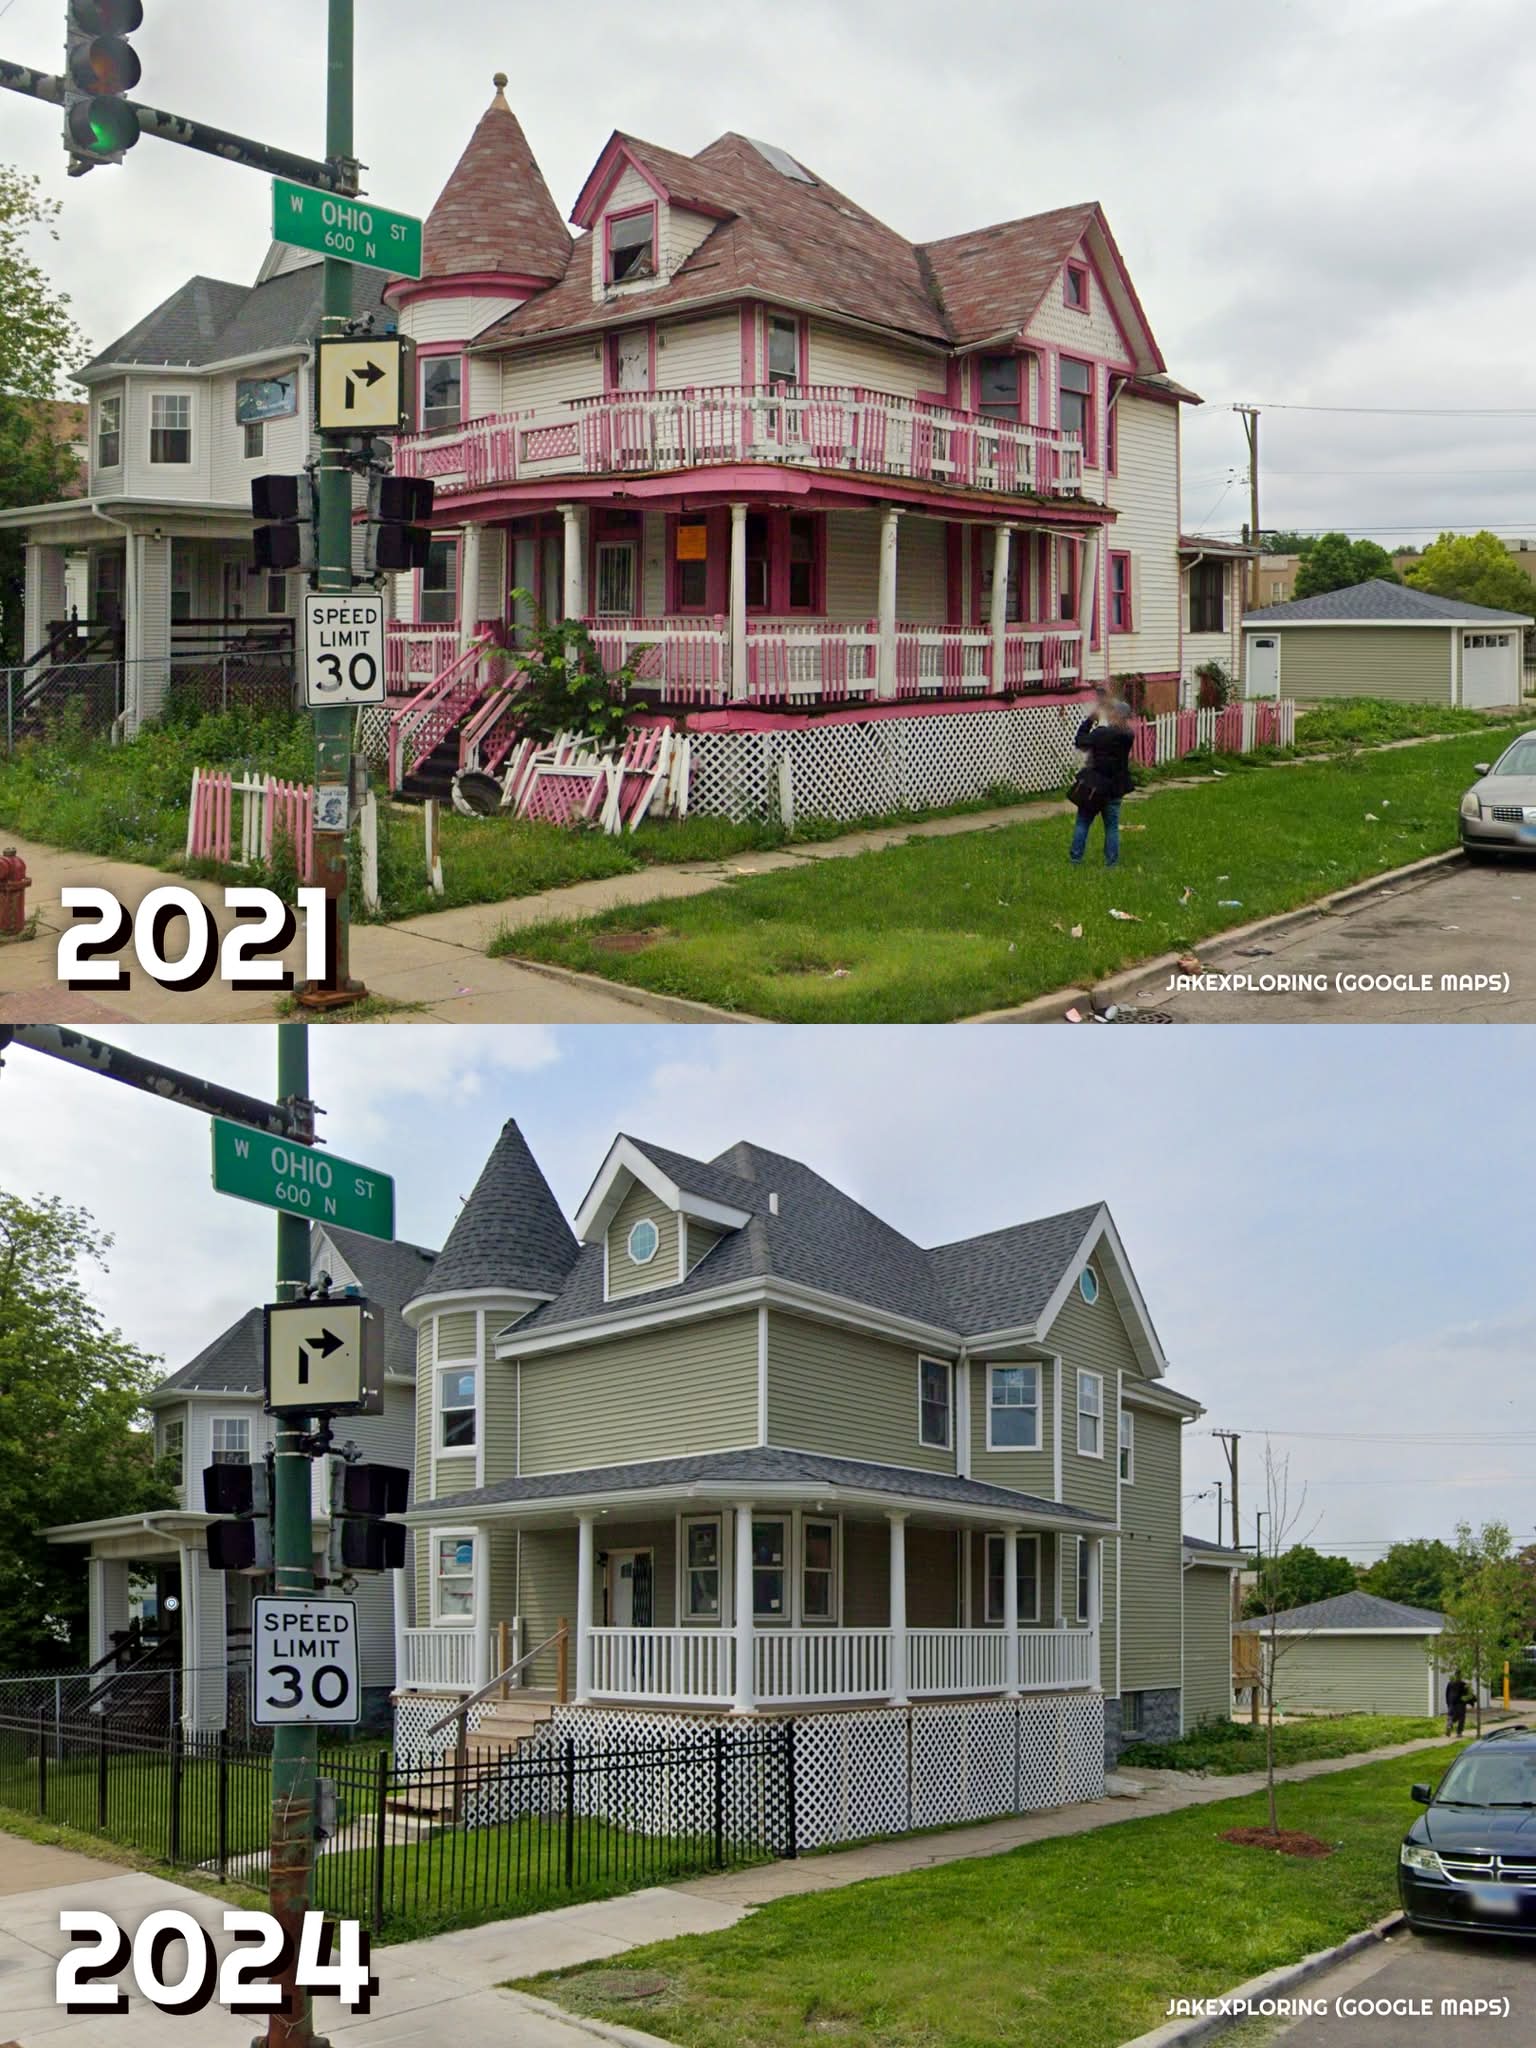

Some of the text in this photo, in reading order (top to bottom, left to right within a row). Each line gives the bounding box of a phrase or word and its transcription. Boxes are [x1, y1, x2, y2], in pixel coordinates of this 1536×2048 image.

[290, 195, 408, 242] W OHIO ST
[324, 231, 376, 259] 600 N
[313, 608, 377, 625] SPEED
[320, 630, 370, 647] LIMIT
[315, 652, 377, 693] 30
[234, 1138, 375, 1199] W OHIO ST
[275, 1182, 337, 1216] 600 N
[264, 1613, 349, 1633] SPEED
[273, 1639, 340, 1658] LIMIT
[265, 1664, 349, 1709] 30
